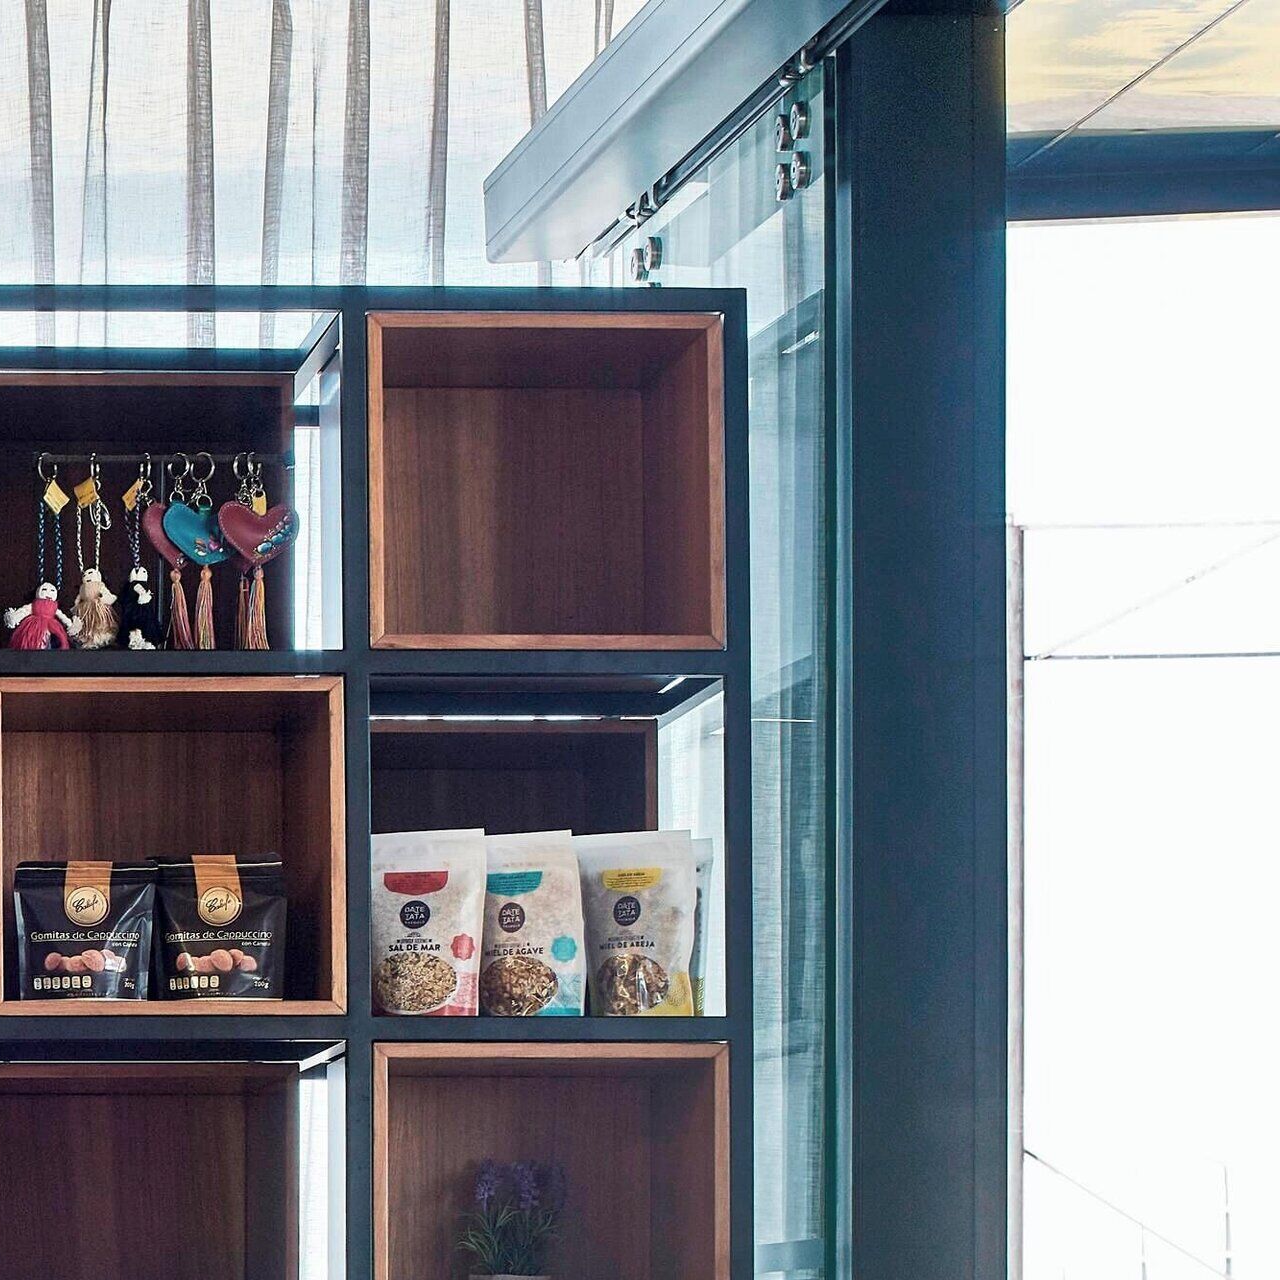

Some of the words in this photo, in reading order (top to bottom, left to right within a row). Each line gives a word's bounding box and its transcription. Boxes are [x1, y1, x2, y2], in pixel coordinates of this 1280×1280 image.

[30, 931, 70, 941] Gomitas
[73, 930, 86, 940] de
[87, 930, 140, 942] Cappuccino
[203, 930, 216, 940] de
[219, 929, 273, 941] Cappuccino
[421, 943, 440, 951] MAR
[630, 941, 655, 949] ABEJA
[503, 948, 515, 956] DE
[516, 947, 543, 955] AGAVE
